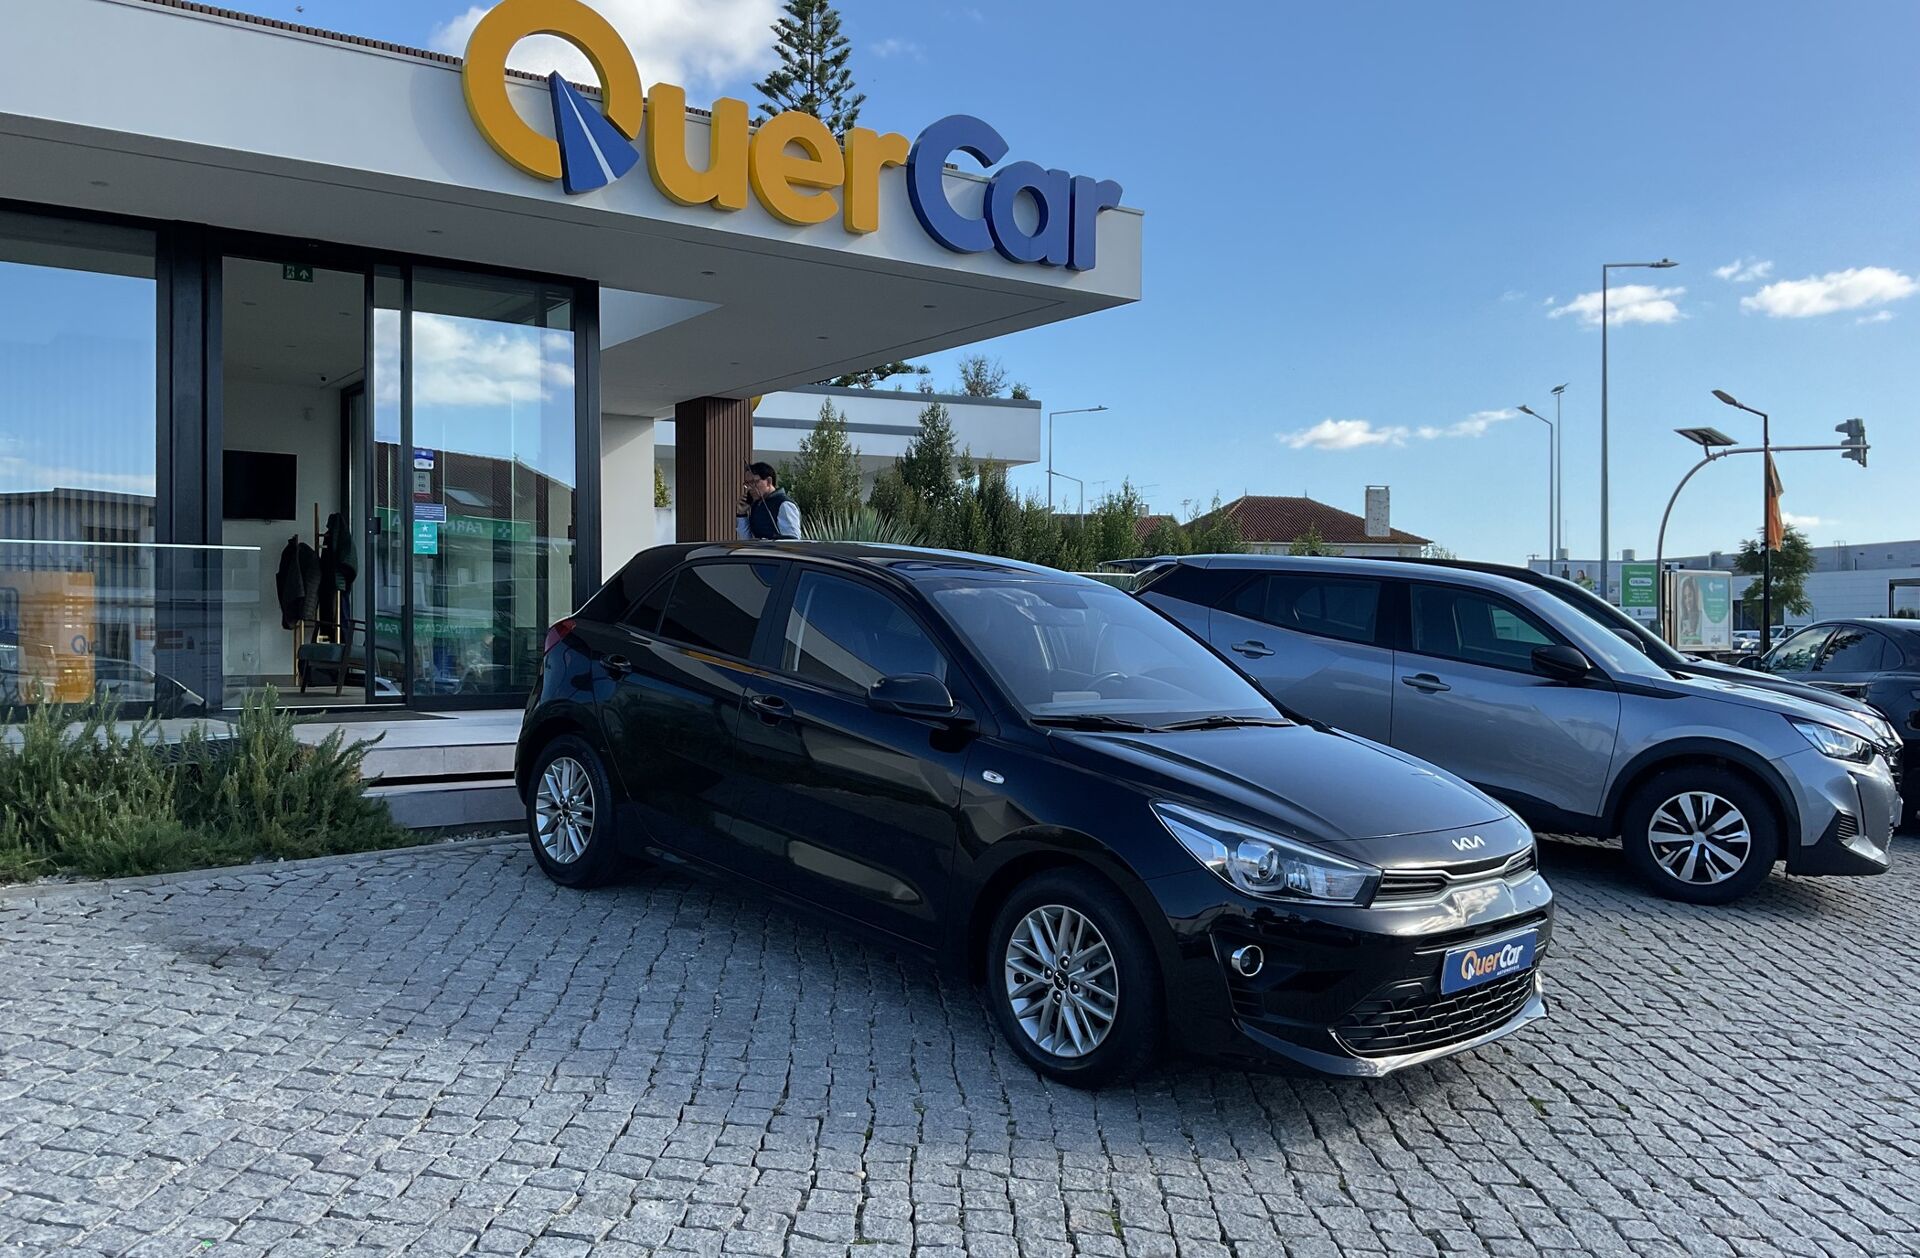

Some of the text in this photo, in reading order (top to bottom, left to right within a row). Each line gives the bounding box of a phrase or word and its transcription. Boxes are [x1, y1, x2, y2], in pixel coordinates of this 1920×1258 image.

[462, 0, 1123, 272] QuerCar
[1452, 835, 1485, 850] KIA
[1461, 944, 1523, 980] QuerCar
